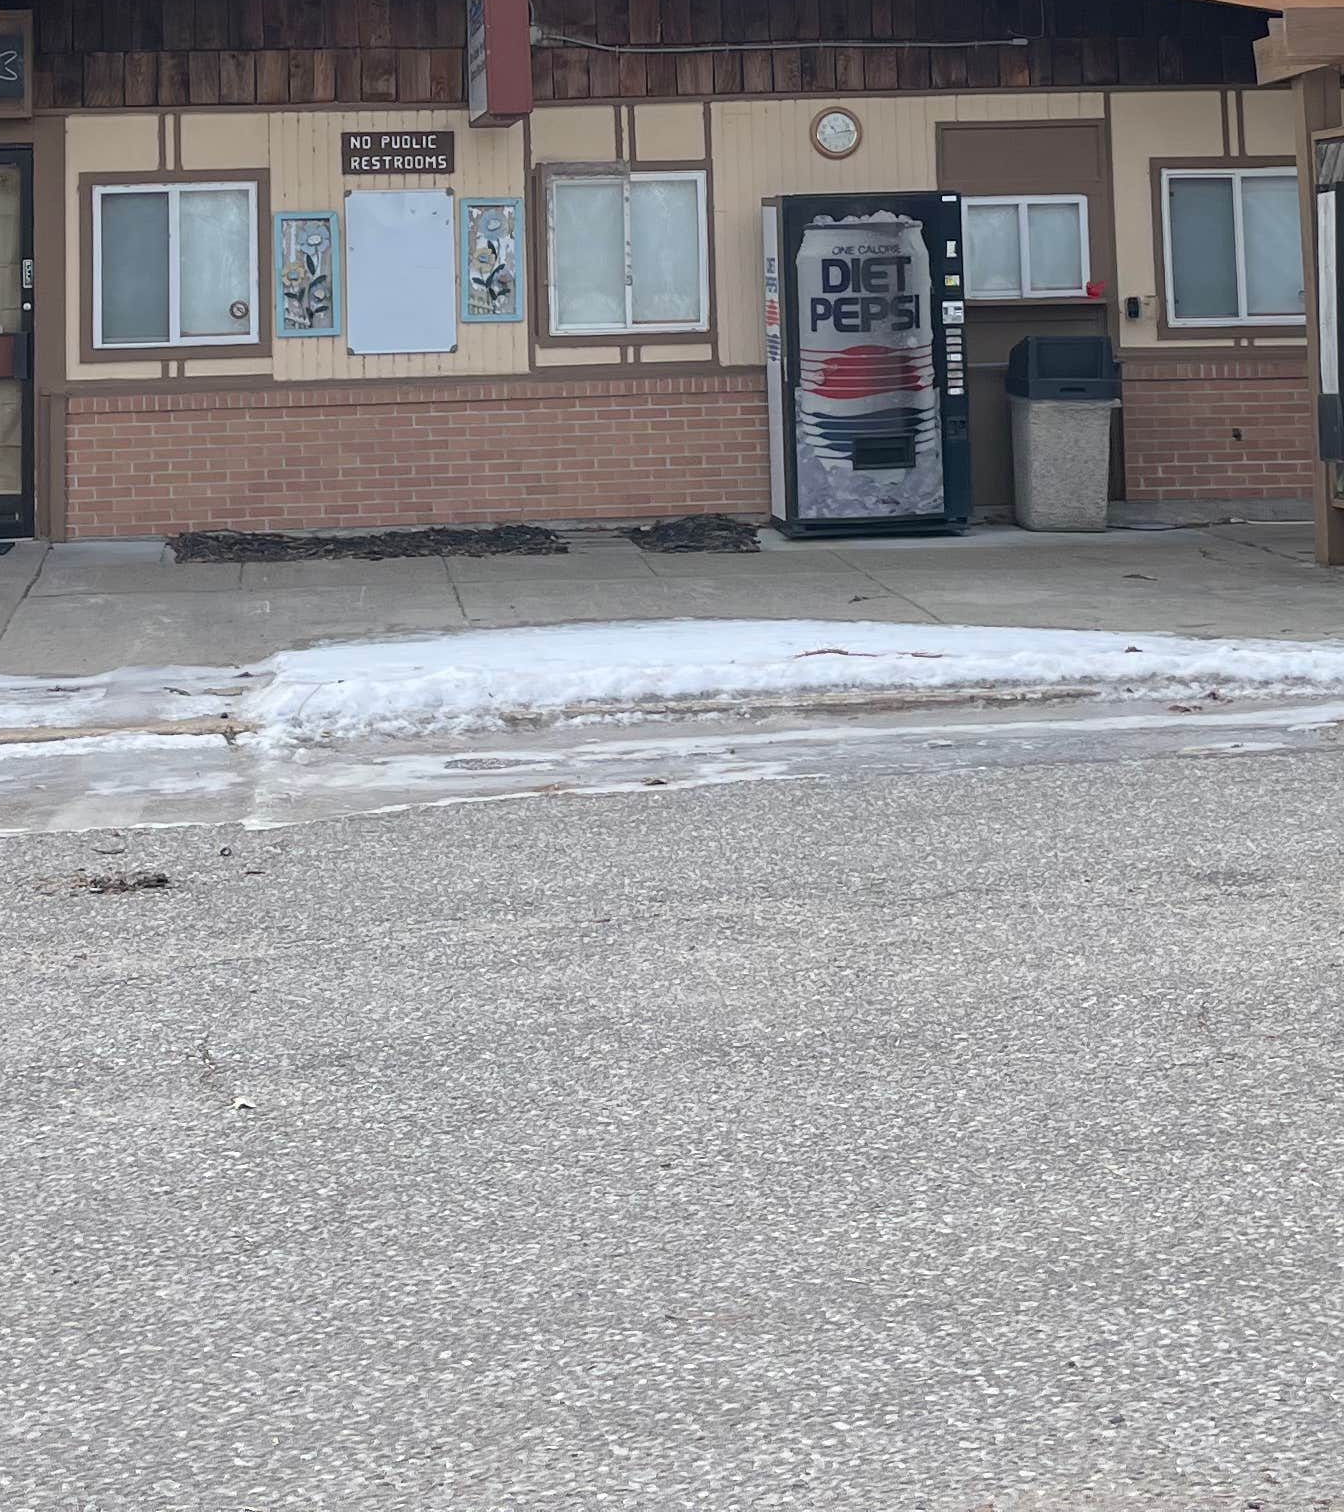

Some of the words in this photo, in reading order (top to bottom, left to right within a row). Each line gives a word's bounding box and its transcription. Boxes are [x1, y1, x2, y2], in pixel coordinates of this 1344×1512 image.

[350, 135, 372, 149] NO
[380, 135, 437, 149] PUBLIC
[350, 155, 448, 169] RESTROOMS
[821, 256, 912, 294] DIET
[811, 294, 920, 333] PEPSI
